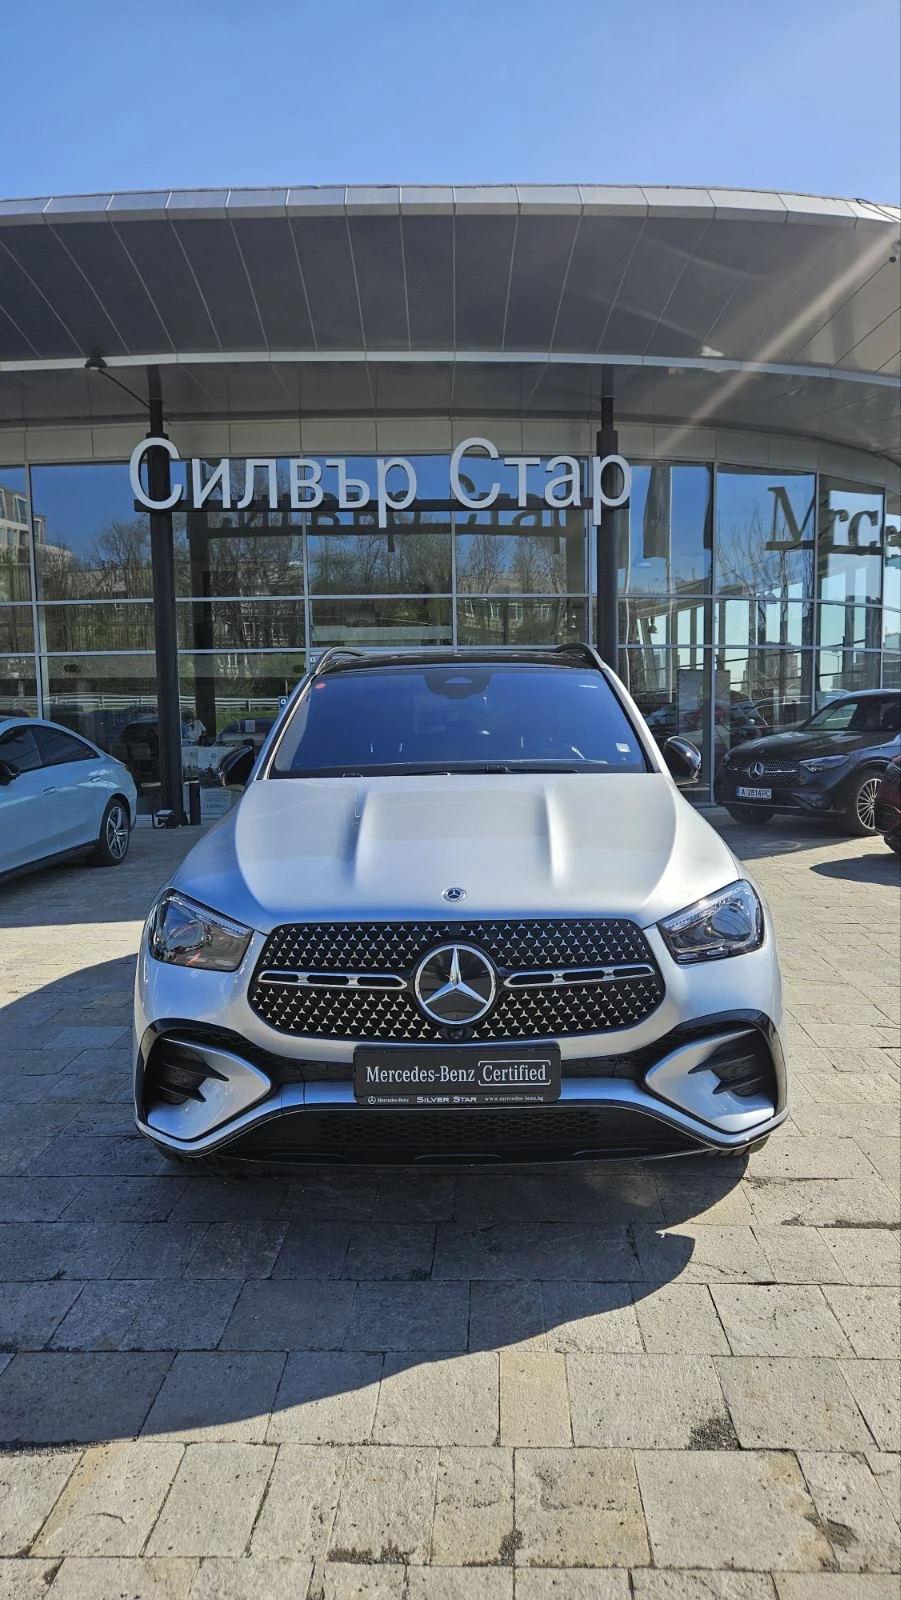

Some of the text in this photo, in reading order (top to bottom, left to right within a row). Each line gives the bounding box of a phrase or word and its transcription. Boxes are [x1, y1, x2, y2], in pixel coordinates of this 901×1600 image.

[130, 437, 632, 528] Силвър Стар
[366, 1064, 546, 1083] Mercedes-Benz Certified
